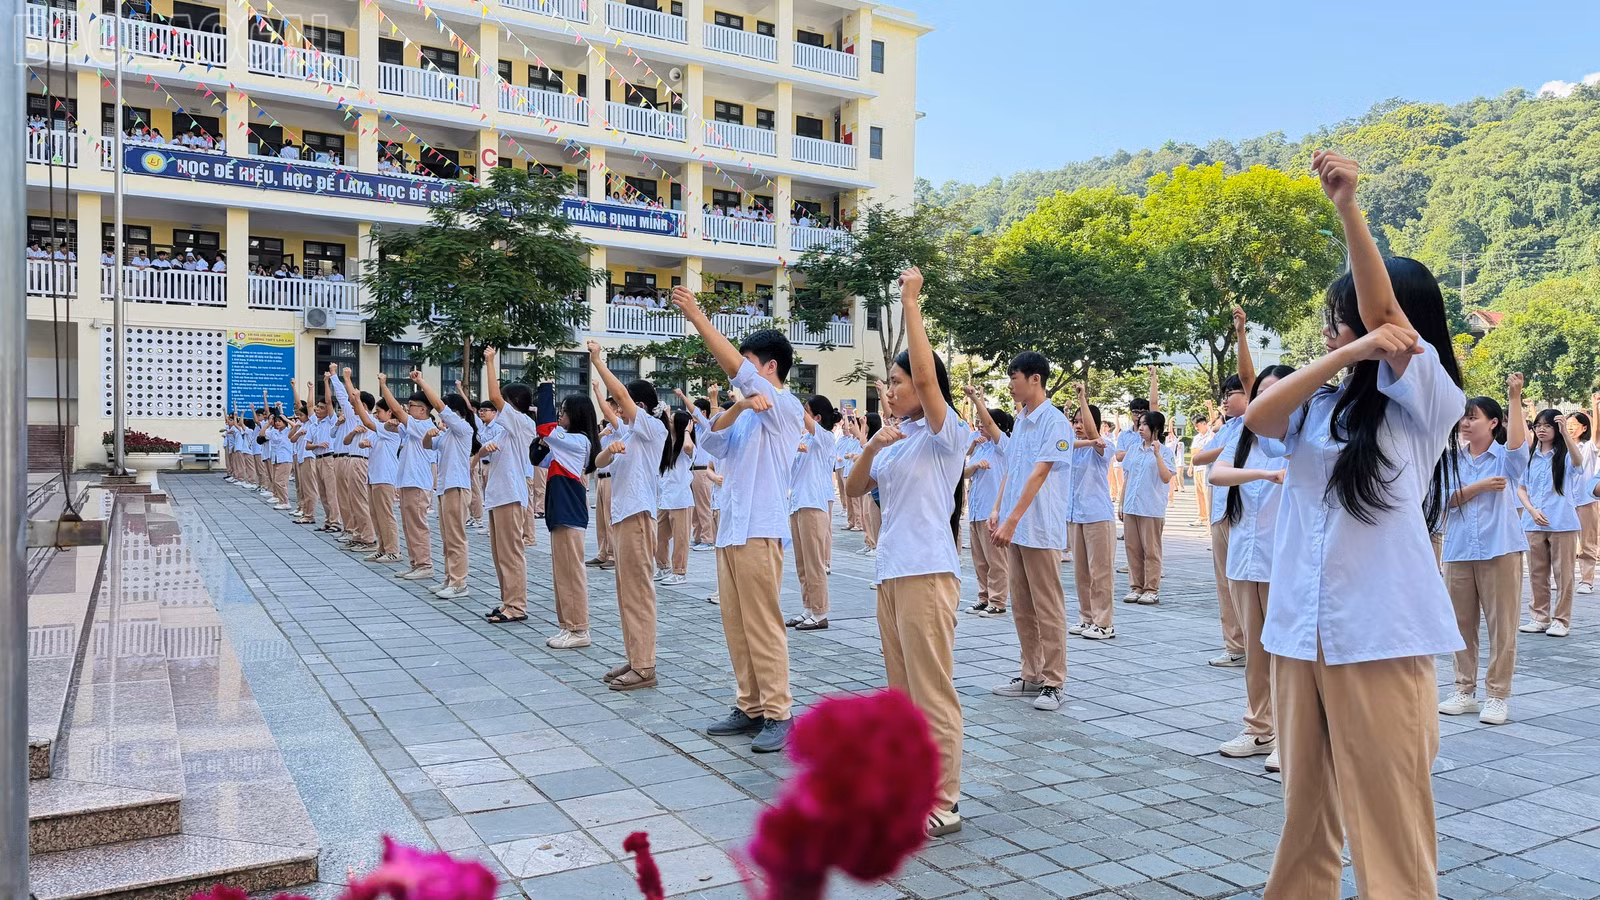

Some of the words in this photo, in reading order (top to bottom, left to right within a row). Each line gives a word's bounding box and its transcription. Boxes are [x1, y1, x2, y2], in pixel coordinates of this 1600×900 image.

[481, 148, 498, 167] C
[177, 159, 210, 178] HỌC
[239, 163, 278, 187] HIỂU,
[282, 171, 313, 190] HỌC
[316, 172, 336, 191] ĐỂ
[377, 183, 406, 200] HỌC
[409, 184, 428, 202] ĐỂ
[609, 212, 637, 229] ĐỊNH
